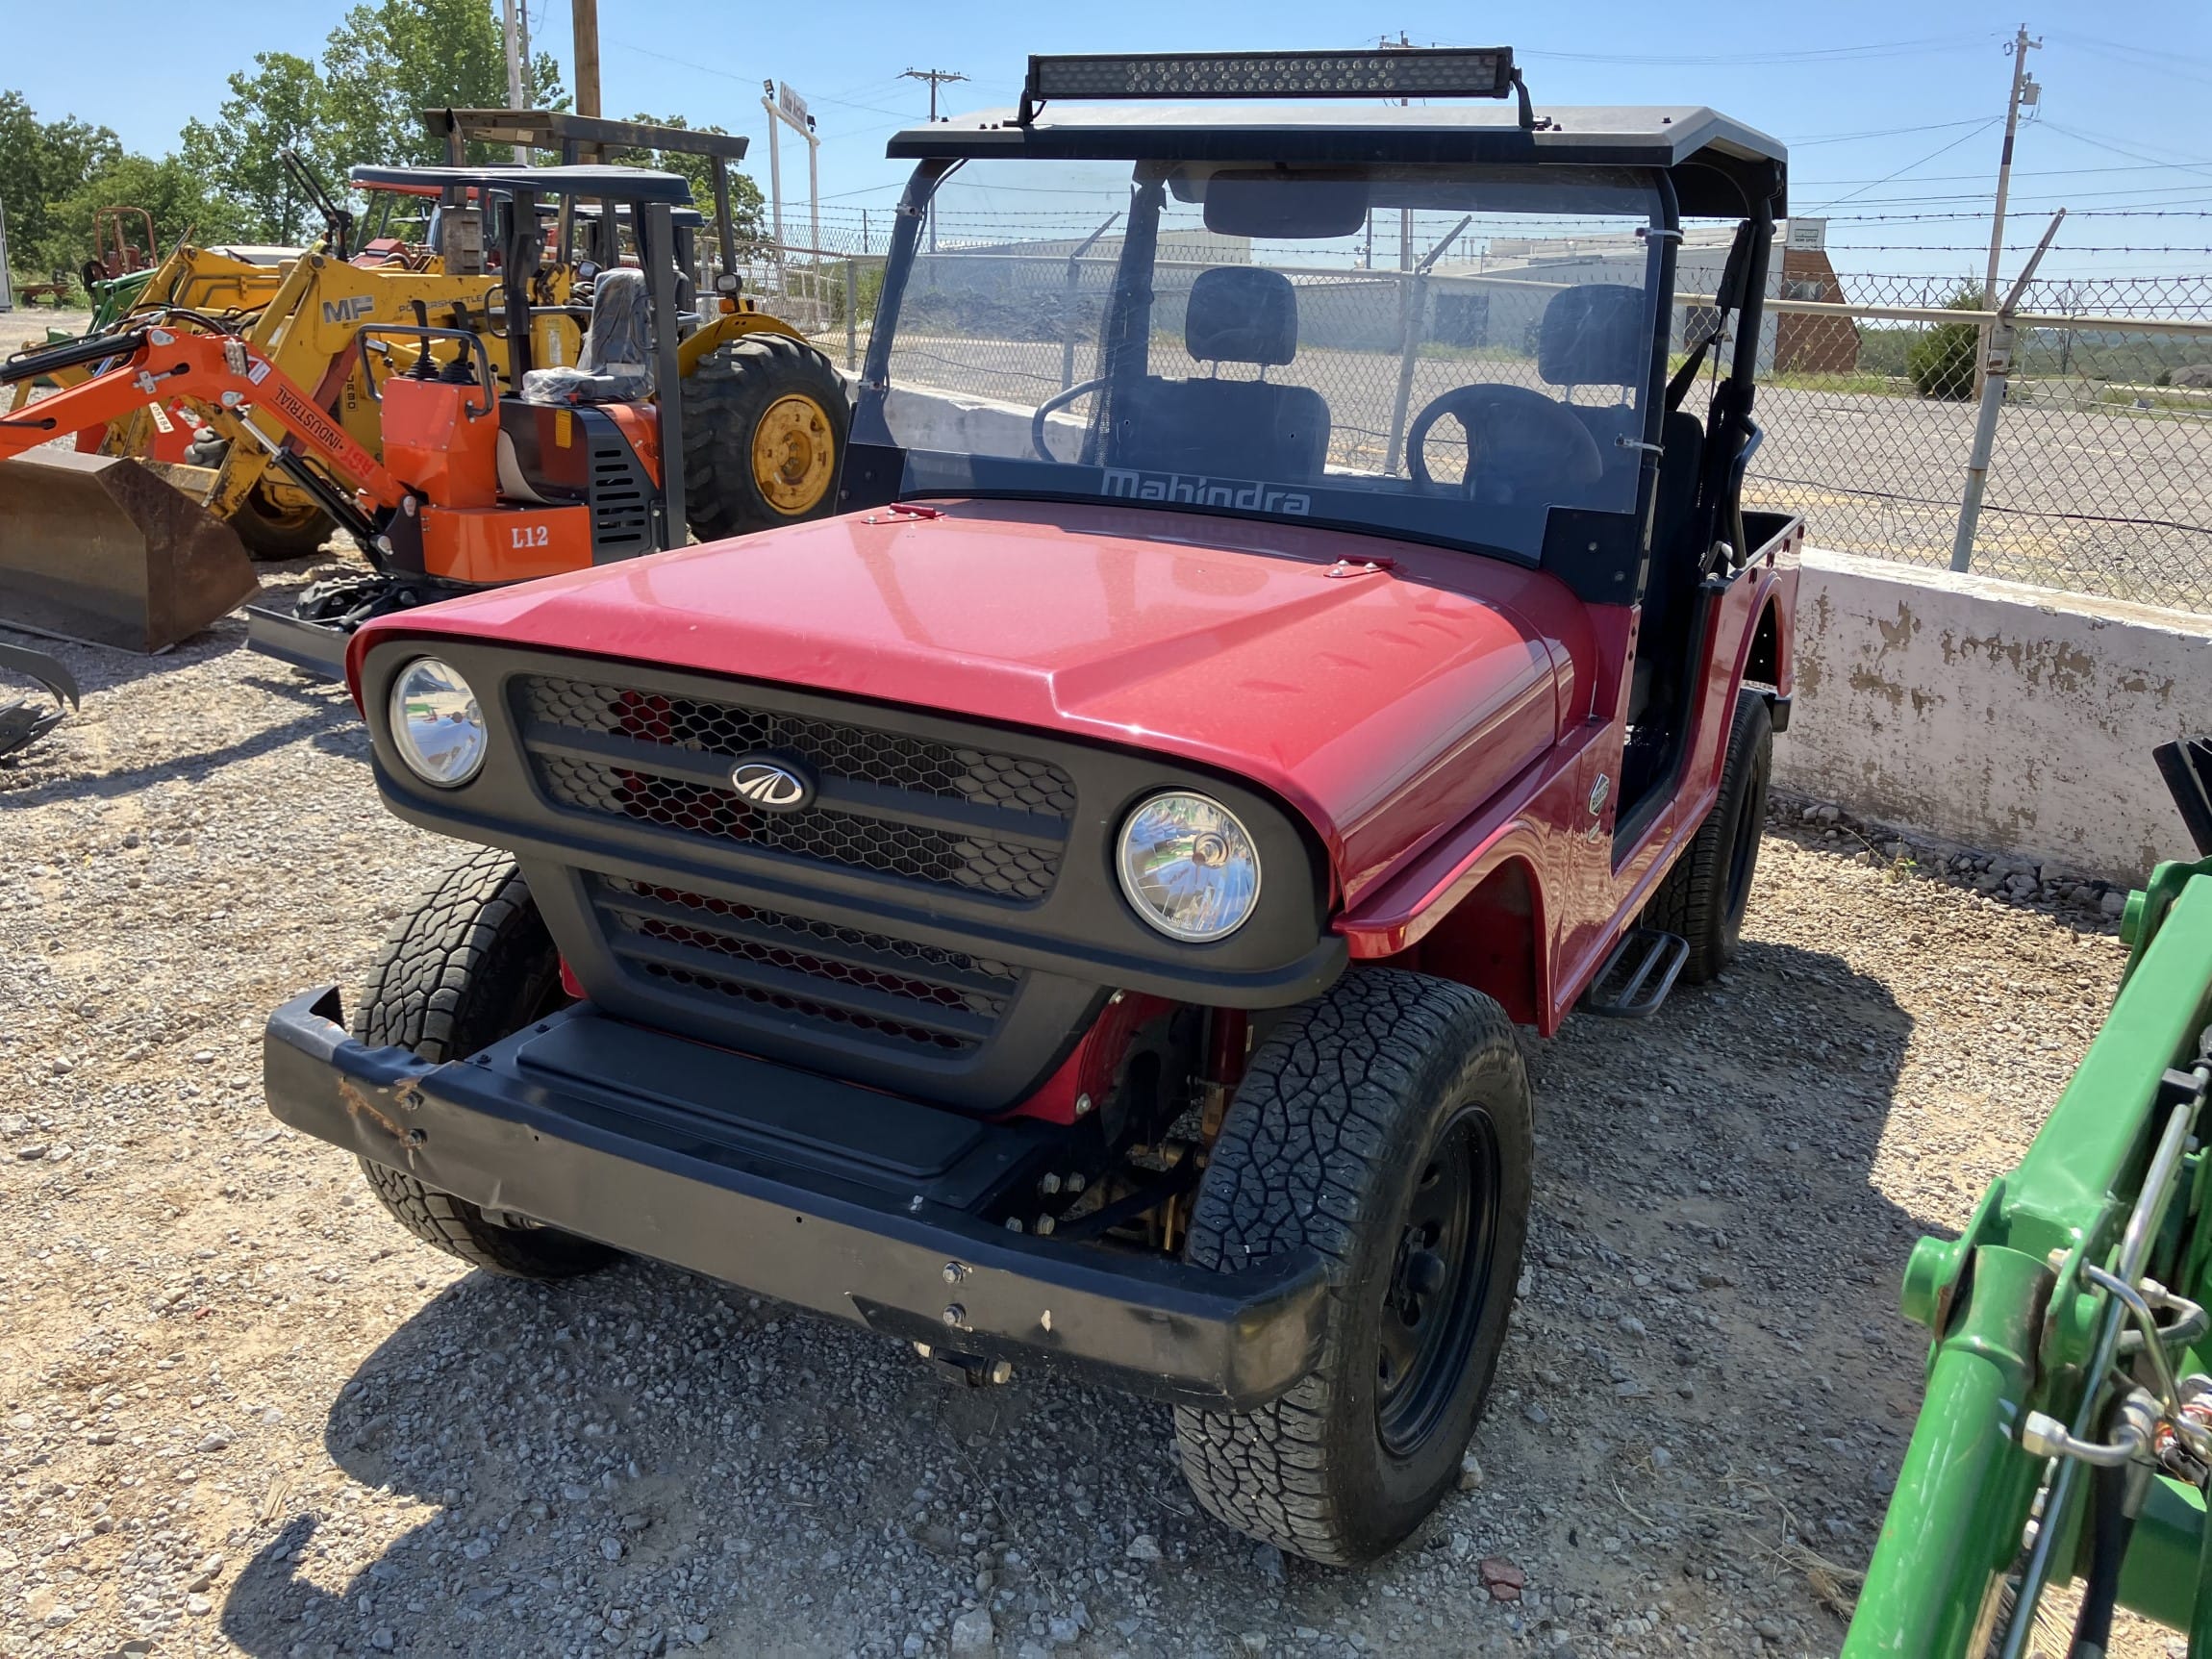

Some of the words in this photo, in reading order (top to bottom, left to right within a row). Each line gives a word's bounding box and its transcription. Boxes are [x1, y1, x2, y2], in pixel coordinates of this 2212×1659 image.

[323, 295, 373, 323] MF
[346, 374, 356, 410] URBO
[1101, 469, 1311, 516] Mahindra
[511, 525, 548, 548] L12
